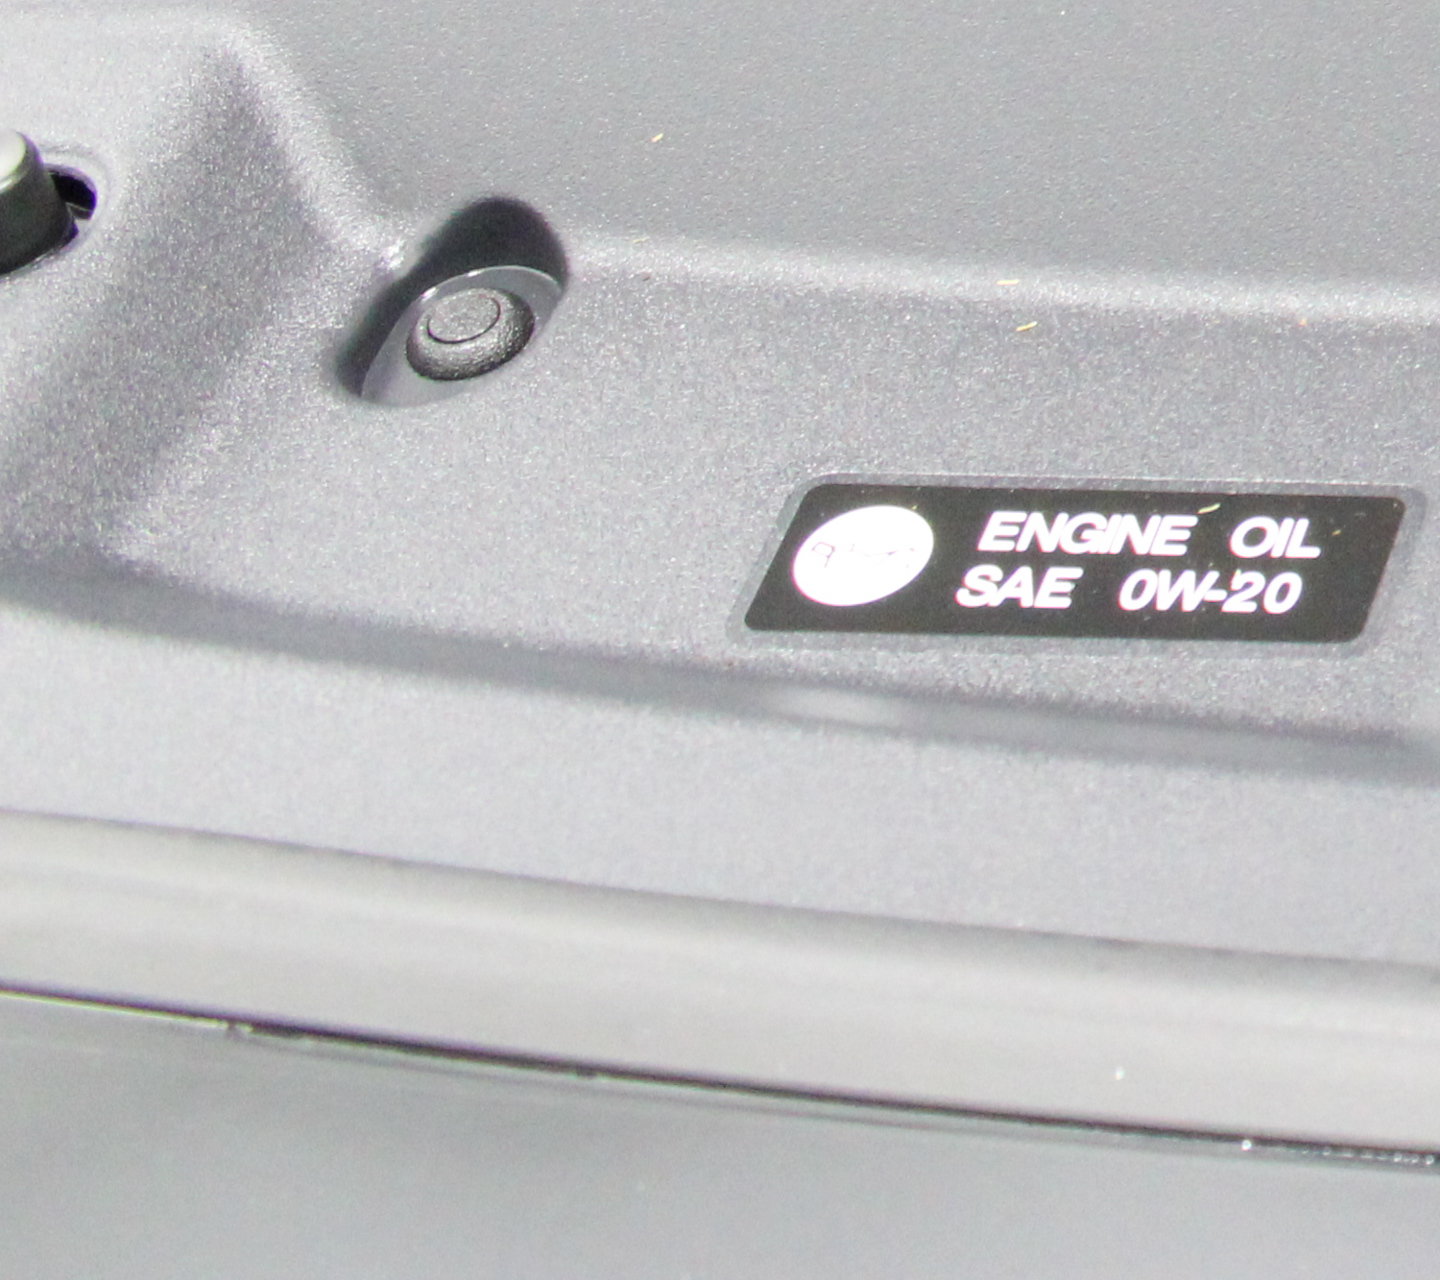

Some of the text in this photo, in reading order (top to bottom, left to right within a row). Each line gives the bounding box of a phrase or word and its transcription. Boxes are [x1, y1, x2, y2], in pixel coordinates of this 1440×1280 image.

[977, 511, 1321, 560] ENGINE OIL
[955, 565, 1303, 615] SAE 0W-20
